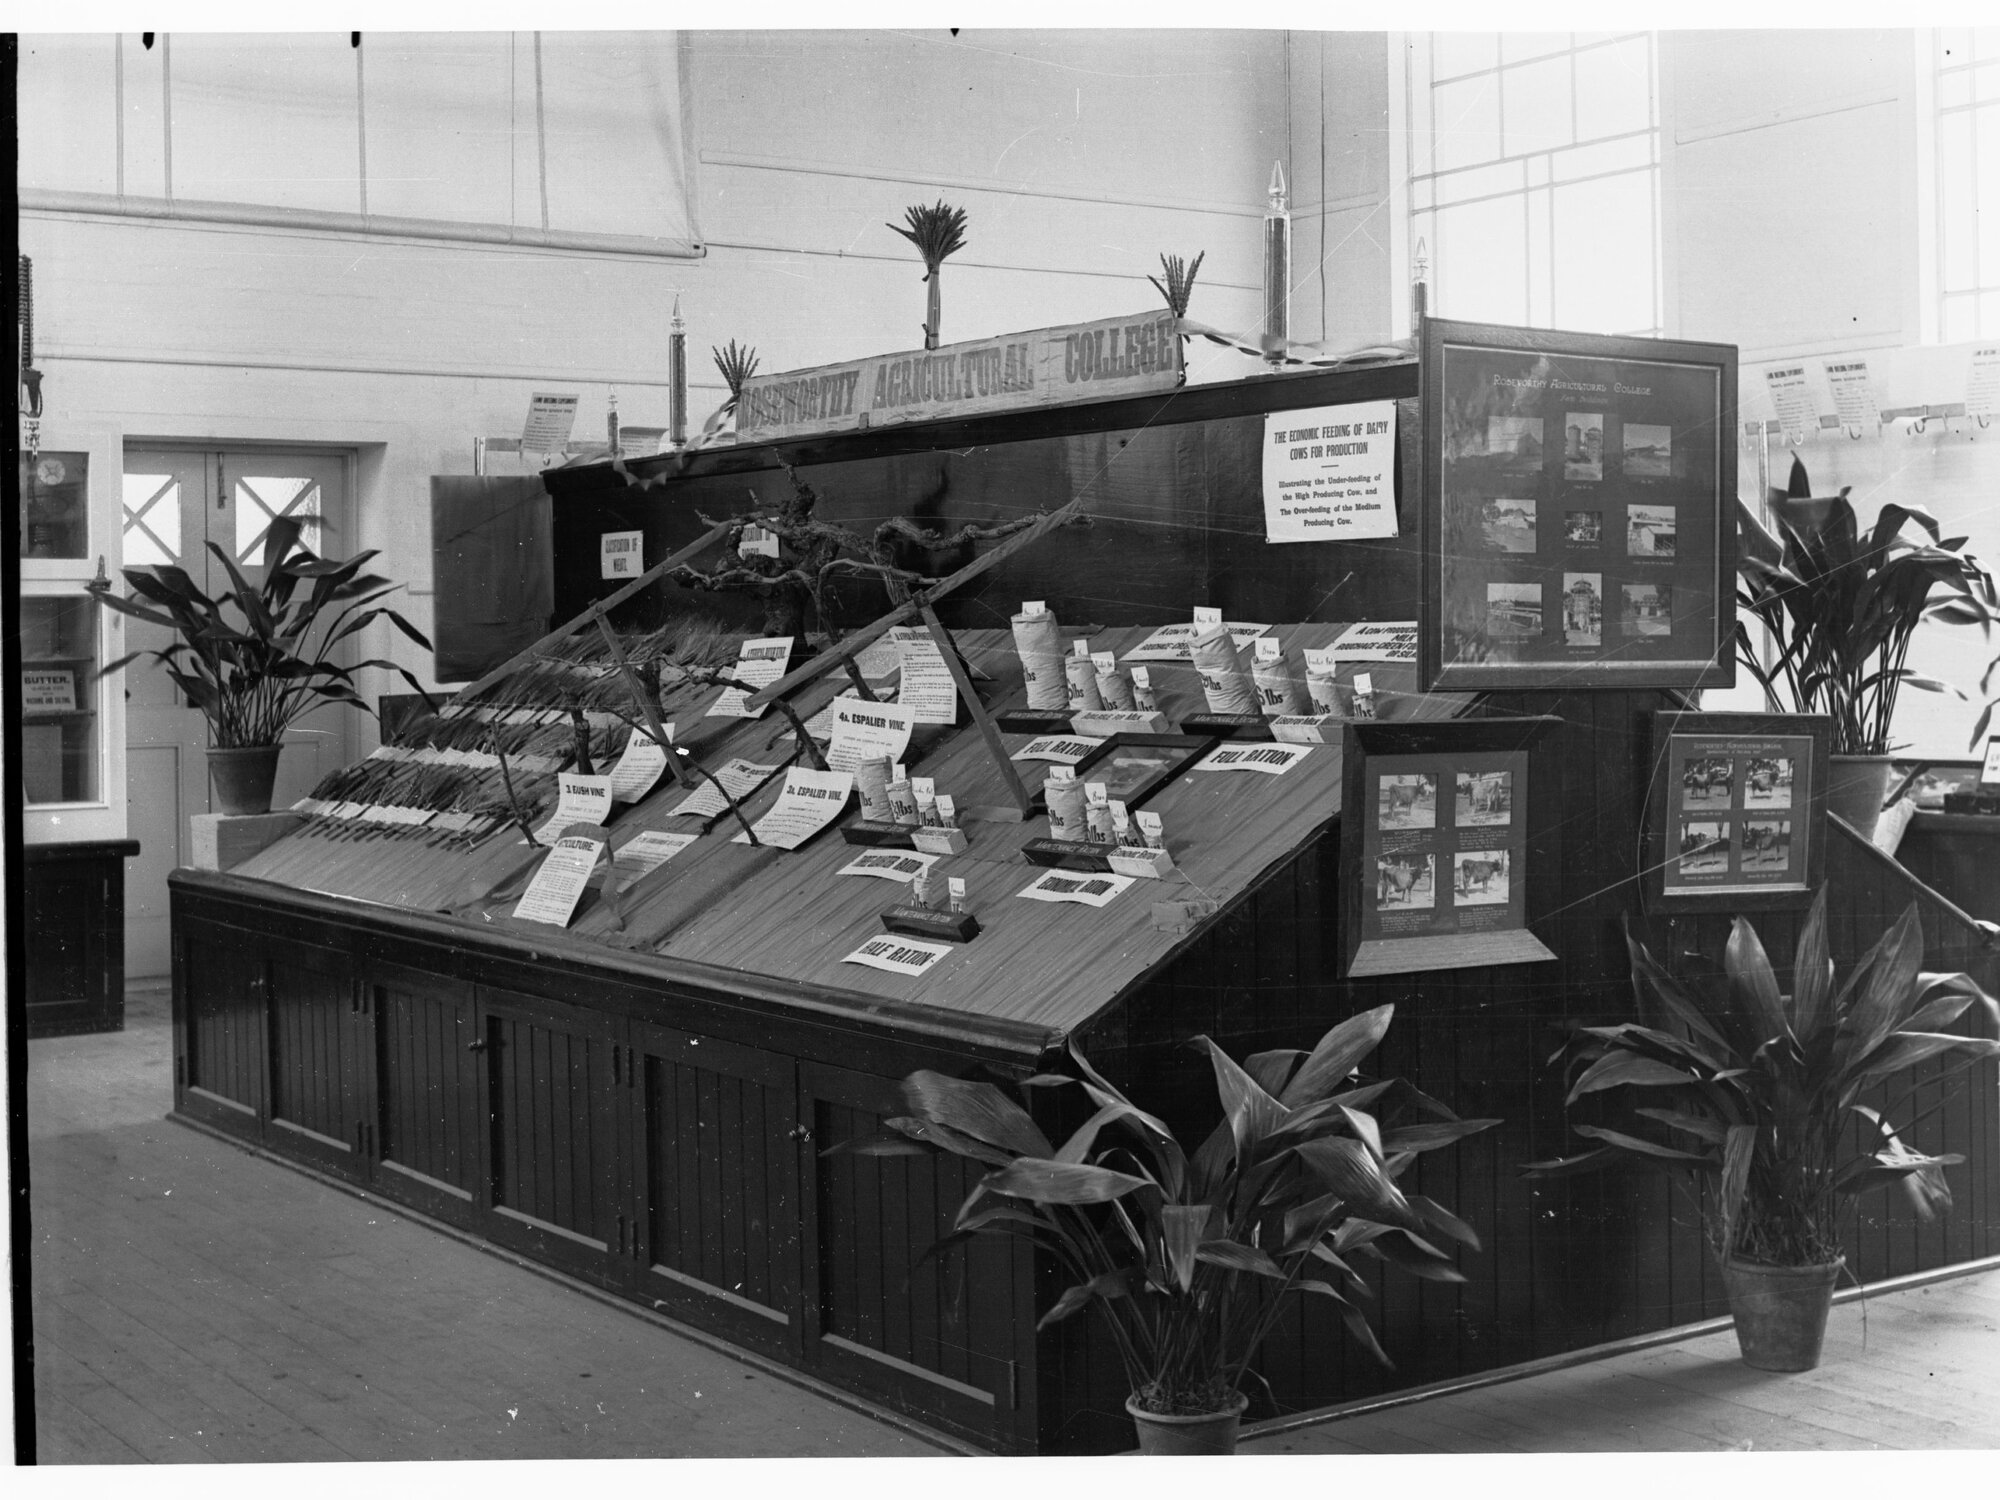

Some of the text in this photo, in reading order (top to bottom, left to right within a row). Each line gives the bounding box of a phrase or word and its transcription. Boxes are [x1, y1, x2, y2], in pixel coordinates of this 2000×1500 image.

[872, 343, 1034, 409] AGRICULTURAL
[1065, 317, 1173, 384] COLLEGE
[1613, 382, 1652, 396] COLLEGE
[1274, 420, 1389, 444] THE ECONOMIC FEEDING OF DAIRY
[1290, 441, 1368, 461] COWS FOR PRODUCTION
[1278, 473, 1381, 489] Illustrating the Under-feeding of
[1282, 492, 1293, 501] the
[1295, 491, 1311, 501] High
[1313, 489, 1345, 499] Producing
[1365, 487, 1378, 495] and
[1280, 502, 1381, 516] The Over-feeding of the Medium
[1303, 516, 1353, 528] Producing Cow.
[1355, 626, 1368, 634] A
[24, 676, 71, 684] BUTTER.
[852, 713, 886, 729] ESPALIER
[888, 720, 907, 731] VINE.
[1023, 740, 1099, 757] FULL RATION
[1210, 749, 1297, 766] FULL RATION
[589, 787, 606, 798] VINE
[797, 785, 827, 800] ESPALIER
[858, 941, 937, 967] HALF RATION
